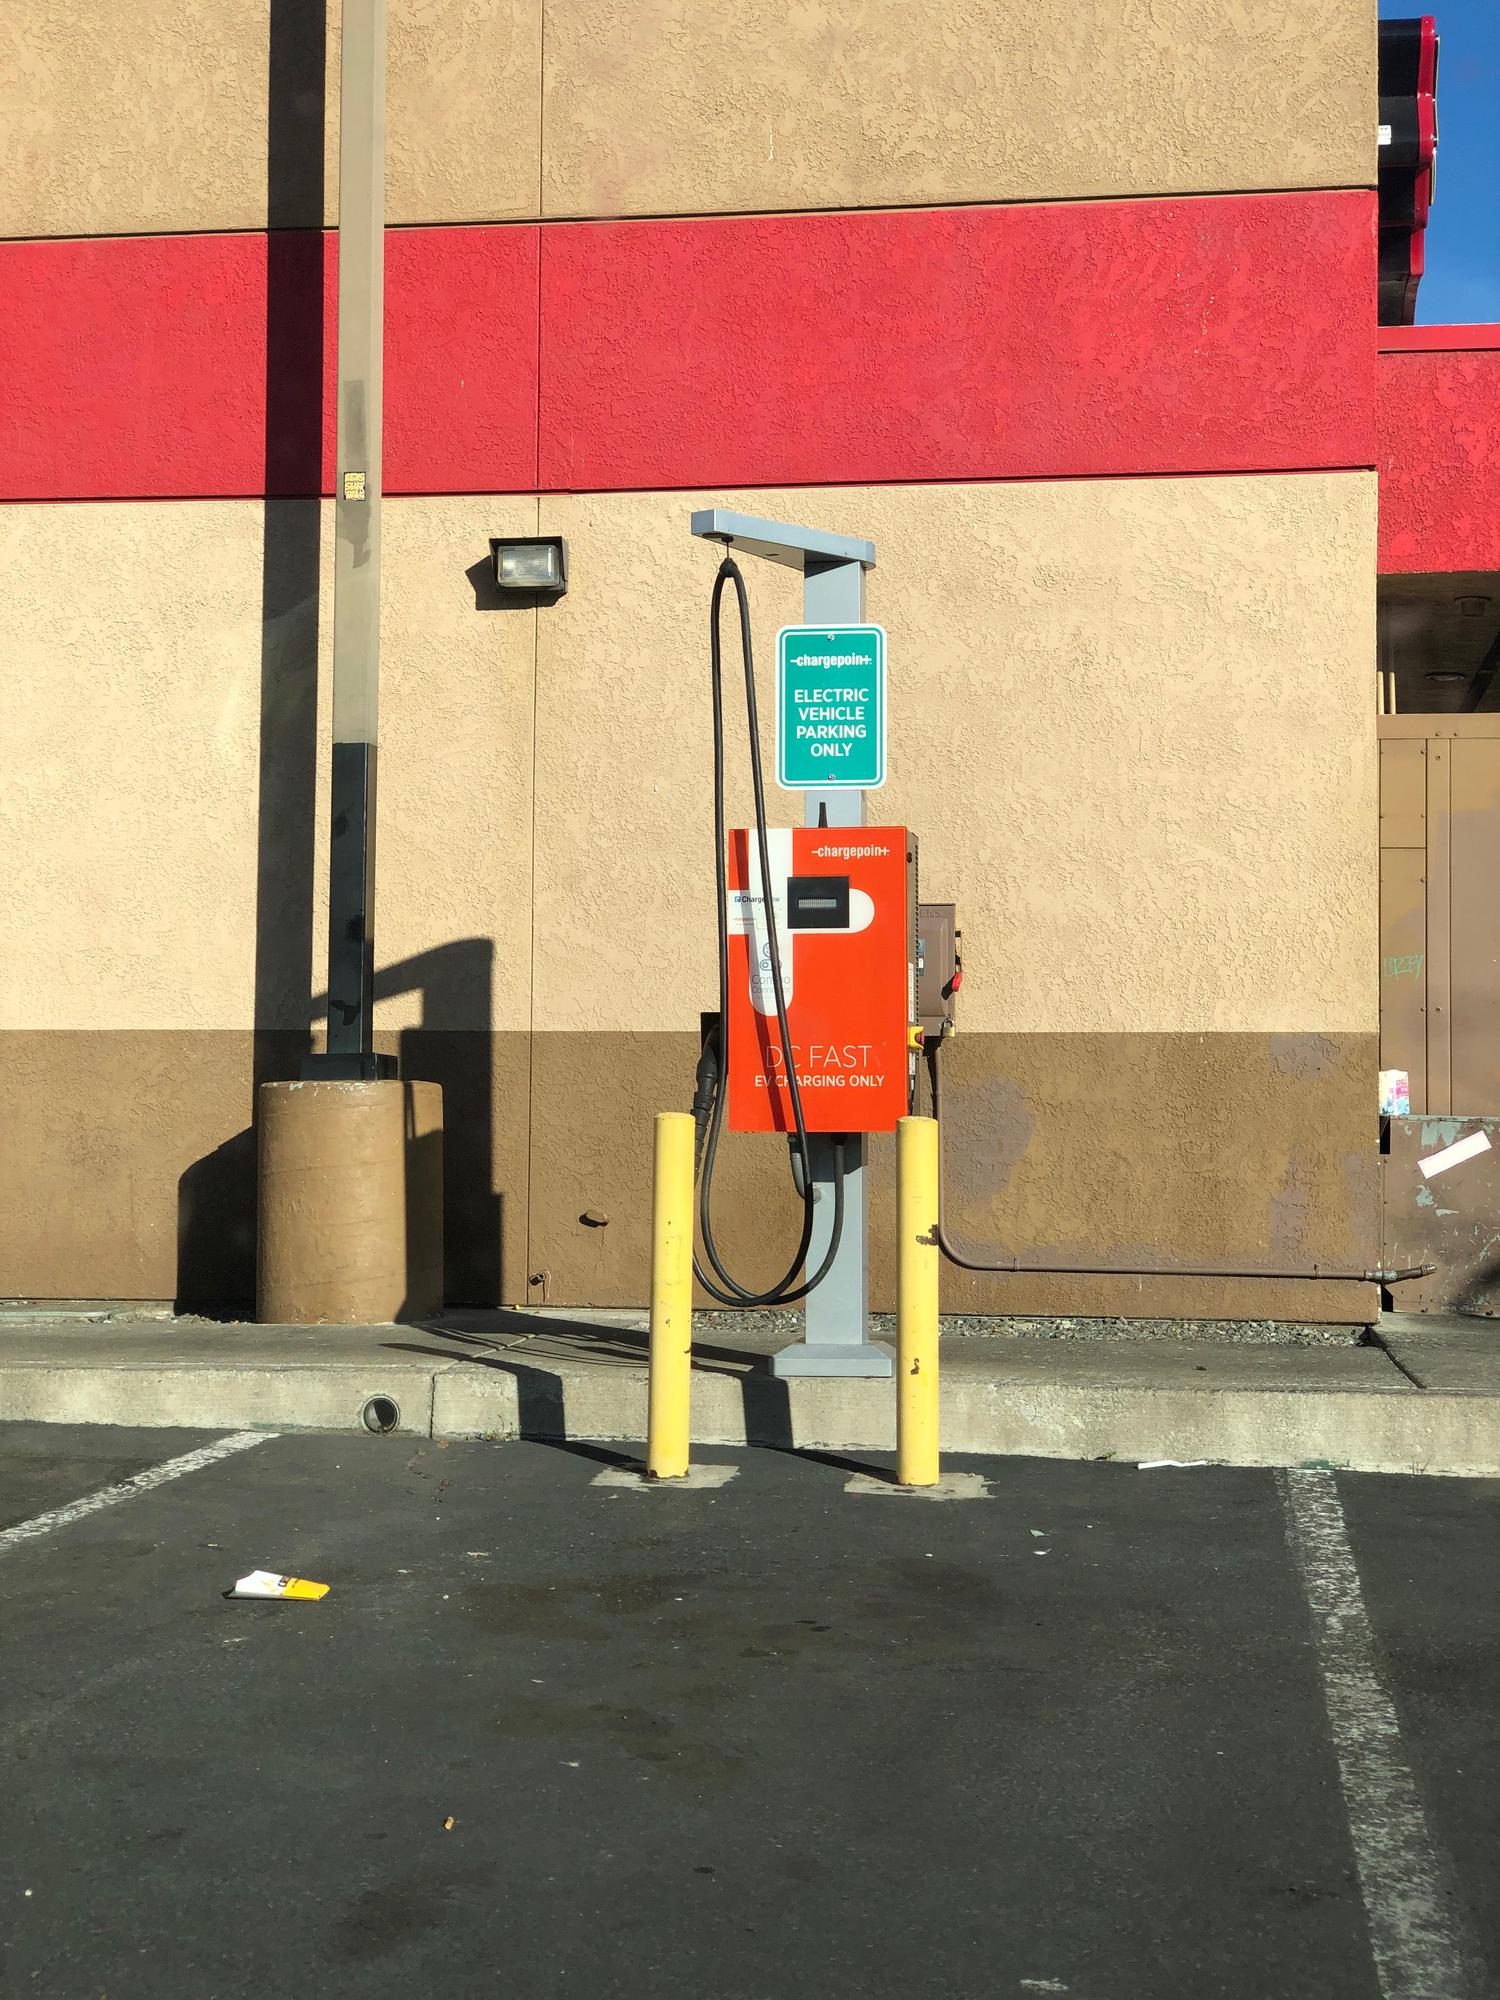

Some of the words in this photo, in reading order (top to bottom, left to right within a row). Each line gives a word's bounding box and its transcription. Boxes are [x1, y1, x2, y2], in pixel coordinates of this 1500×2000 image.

[794, 688, 869, 703] ELECTRIC
[798, 706, 865, 721] VEHICLE
[796, 724, 867, 739] PARKING
[810, 742, 853, 757] ONLY
[809, 1045, 873, 1068] FAST
[754, 1075, 772, 1087] EV
[849, 1074, 885, 1087] ONLY
